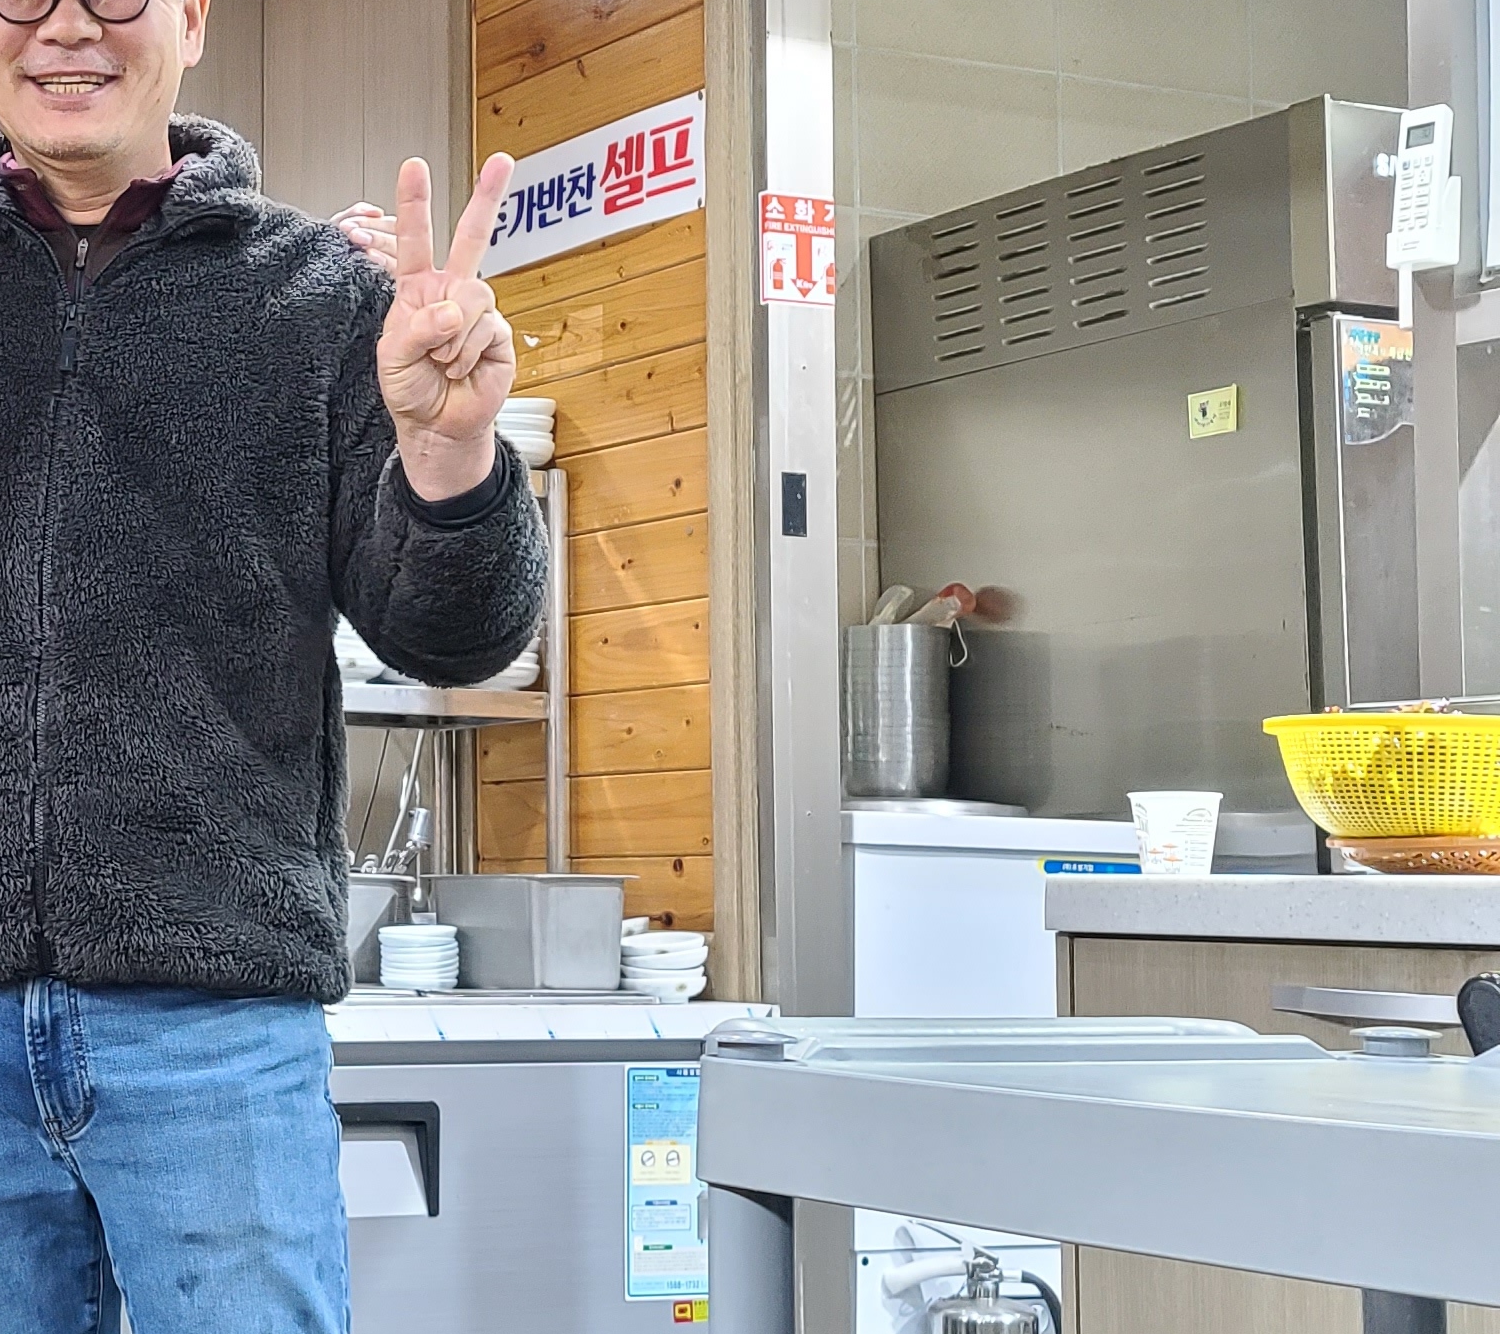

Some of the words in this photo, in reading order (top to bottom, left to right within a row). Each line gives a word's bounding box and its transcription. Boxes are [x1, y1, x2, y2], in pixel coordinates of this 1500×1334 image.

[599, 116, 696, 216] 셀프
[764, 220, 783, 231] FIRE
[783, 222, 835, 236] EXTINGUISH
